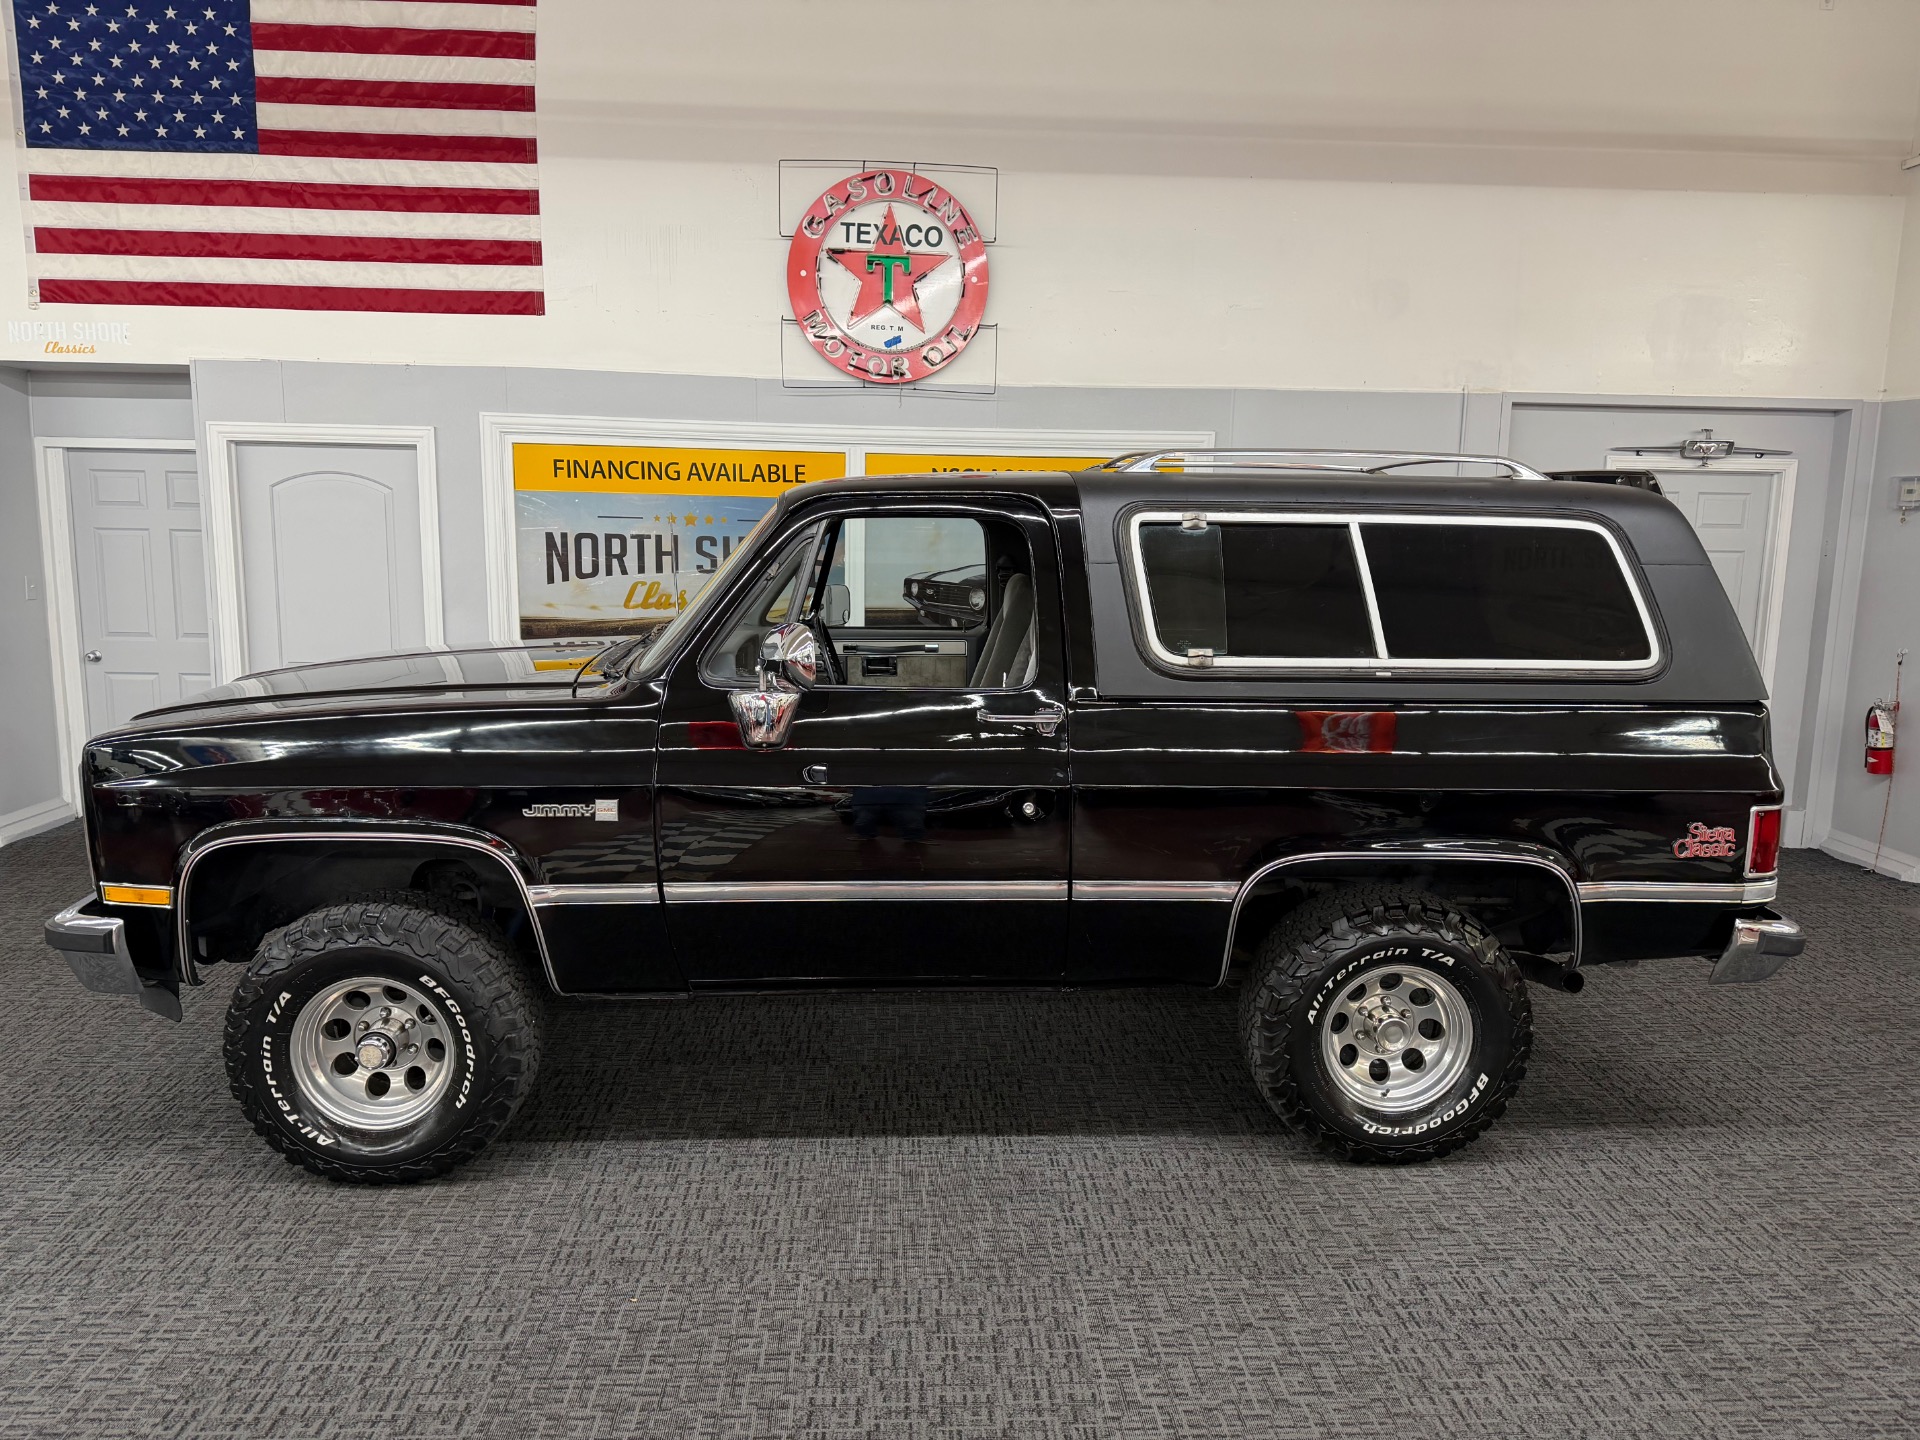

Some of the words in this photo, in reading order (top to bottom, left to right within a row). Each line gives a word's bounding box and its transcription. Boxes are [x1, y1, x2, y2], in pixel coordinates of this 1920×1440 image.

[802, 171, 980, 249] GASOLINE
[840, 221, 944, 248] TEXACO
[866, 254, 912, 306] T
[803, 310, 912, 380] MOTOR
[922, 324, 973, 368] OIL
[553, 458, 681, 481] FINANCING
[687, 462, 807, 483] AVAILABLE
[545, 531, 680, 585] NORTH
[623, 580, 688, 611] Clas
[1672, 835, 1736, 858] Classic
[265, 990, 292, 1024] T/A
[1307, 947, 1409, 1025] All-Terrain
[1421, 948, 1456, 967] T/A
[418, 975, 476, 1109] BFGoodrich
[260, 1035, 336, 1147] All-Terrain
[1362, 1072, 1489, 1136] BFGoodrich
